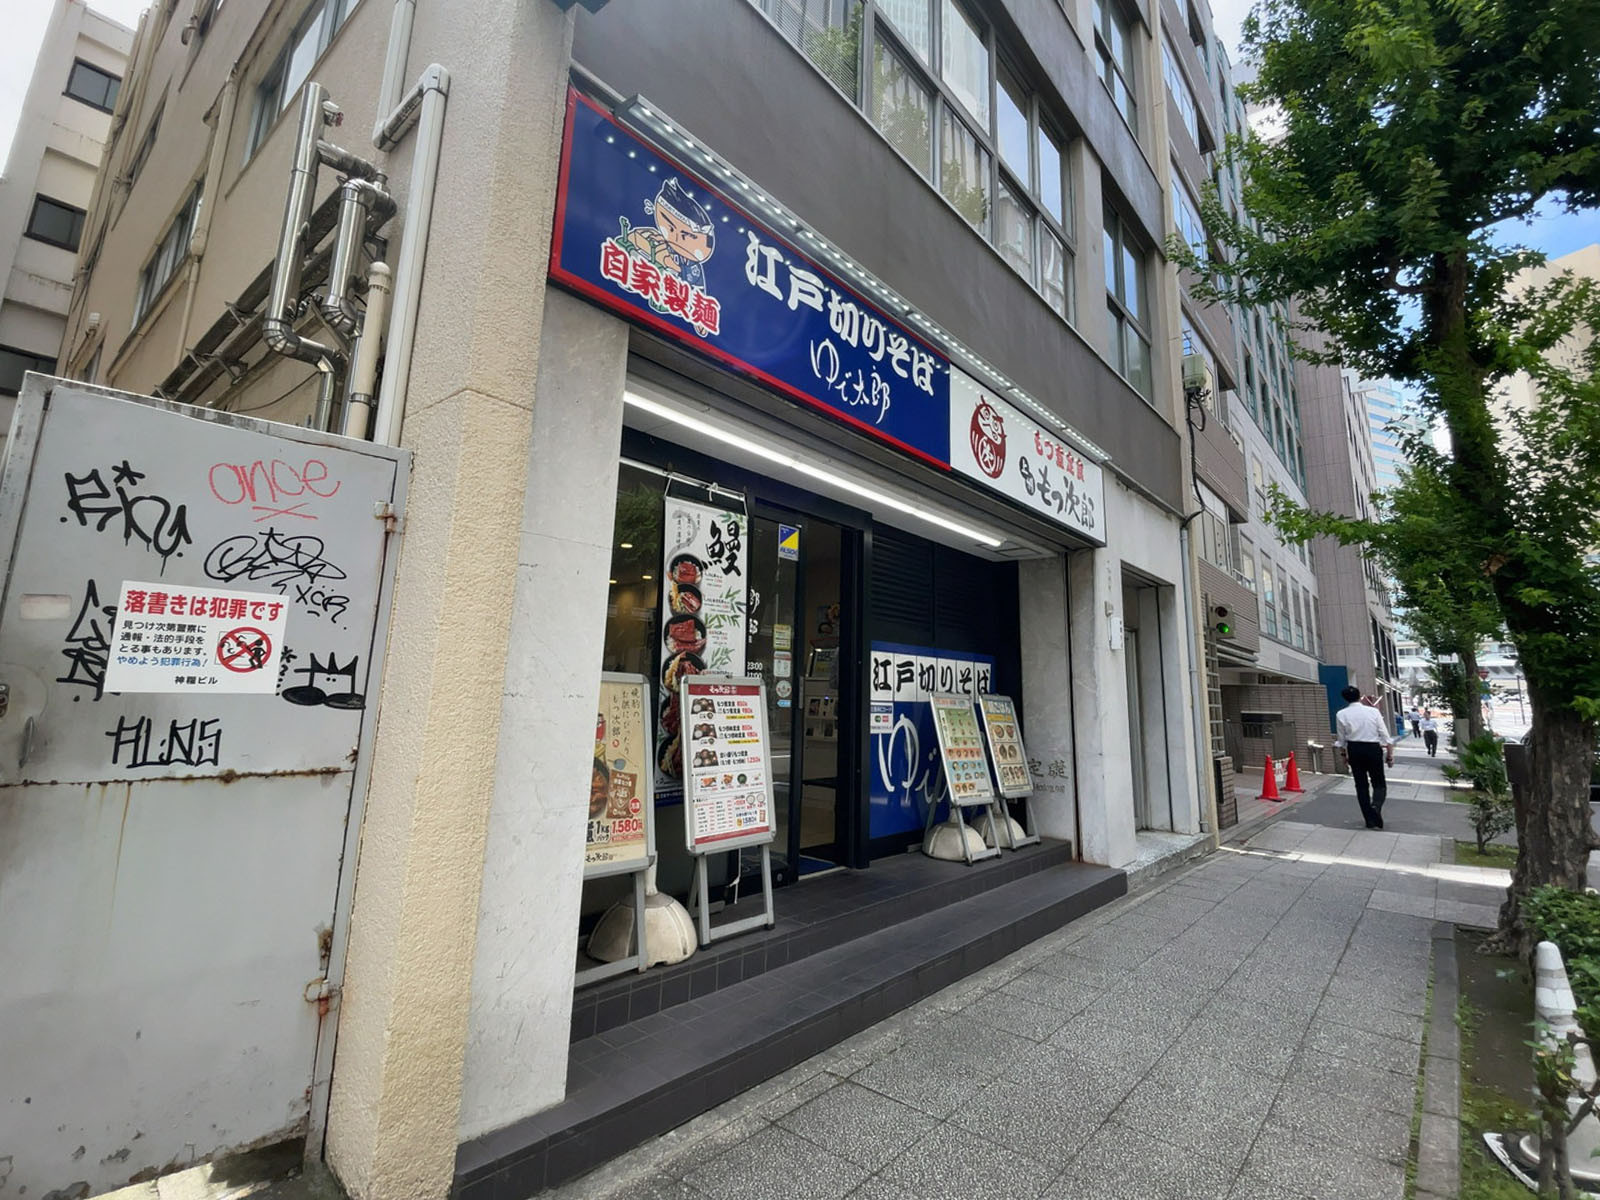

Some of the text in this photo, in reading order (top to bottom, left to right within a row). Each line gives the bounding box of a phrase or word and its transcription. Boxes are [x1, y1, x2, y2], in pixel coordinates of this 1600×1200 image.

[602, 240, 720, 334] 自家製麺
[745, 230, 935, 397] 江戸切りそば
[810, 337, 891, 425] ゆで太郎
[1036, 464, 1095, 531] もつ次郎
[702, 519, 742, 577] 鰻
[122, 619, 207, 634] 見つけ次第警察に
[124, 589, 284, 622] 落書きは犯罪です
[118, 643, 208, 657] とる事もあります。
[119, 631, 206, 645] 通報・法的手段を
[873, 656, 991, 695] 江戸切りそば
